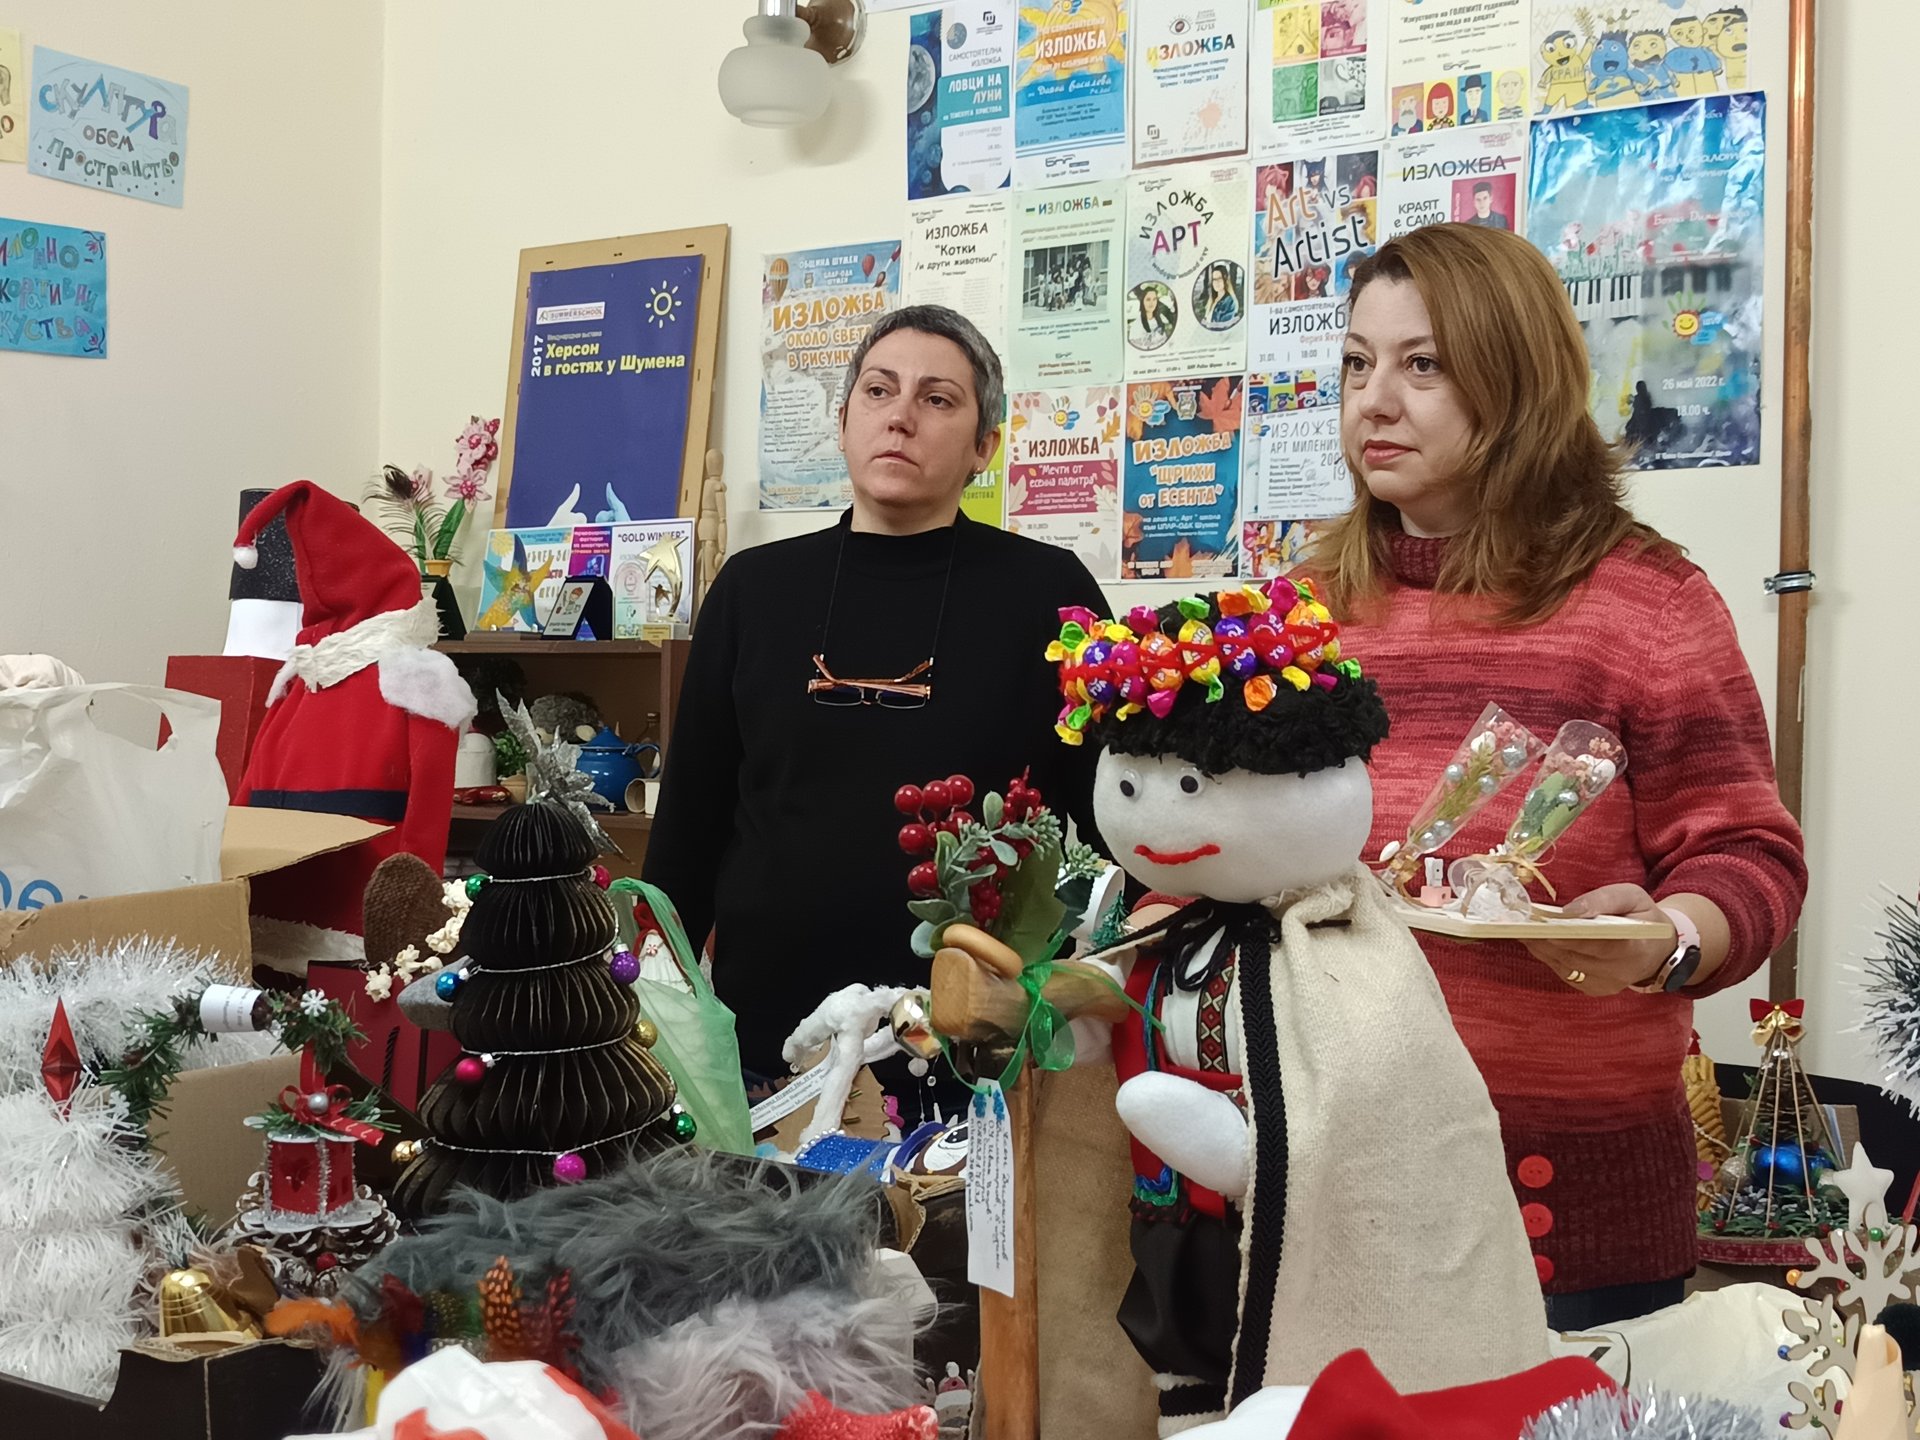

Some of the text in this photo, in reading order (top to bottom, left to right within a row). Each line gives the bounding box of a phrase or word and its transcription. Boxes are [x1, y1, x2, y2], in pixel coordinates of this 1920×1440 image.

[1449, 3, 1482, 16] ГОЛЕМИТЕ
[1035, 29, 1107, 60] ИЗЛОЖБА
[1146, 34, 1236, 61] ИЗЛОЖБА
[949, 47, 1002, 62] САМОСТОЯТЕЛНА
[971, 56, 1002, 68] ИЗЛОЖБА
[948, 72, 1002, 93] ЛОВЦИ НА
[973, 90, 1002, 105] ЛУНИ
[1402, 155, 1507, 182] ИЗЛОЖБА
[1038, 195, 1100, 215] ИЗЛОЖБА
[1268, 186, 1351, 234] Art vs
[1398, 199, 1440, 215] КРАЯТ
[1139, 190, 1214, 240] ИЗЛОЖБА
[1393, 211, 1446, 228] е САМО
[925, 222, 988, 240] ИЗЛОЖБА
[1152, 220, 1202, 256] АРТ
[935, 244, 976, 256] "Котки
[1274, 215, 1369, 278] Artist
[799, 254, 859, 269] ОБЩИНА ШУМЕН
[915, 262, 924, 271] /и
[927, 260, 950, 270] други
[772, 289, 885, 333] ИЗЛОЖБА
[1284, 302, 1335, 314] самостоятелна
[785, 329, 829, 350] ОКОЛО
[531, 335, 544, 377] 2017
[545, 343, 600, 360] Херсон
[788, 347, 857, 371] В РИСУНК
[544, 353, 686, 376] в гостях у Шумена
[1662, 376, 1726, 390] 26 май 2022 г.
[1676, 404, 1701, 416] 18.00
[1028, 436, 1100, 458] ИЗЛОЖБА
[1133, 431, 1232, 464] ИЗЛОЖБА
[1270, 441, 1288, 454] АРТ
[1038, 464, 1084, 475] "Мечти от
[1150, 463, 1216, 485] "ЩРИХИ
[1029, 473, 1098, 488] есенна палитра"
[1158, 485, 1225, 508] ЕСЕНТА"
[618, 530, 686, 543] "GOLD WINER"
